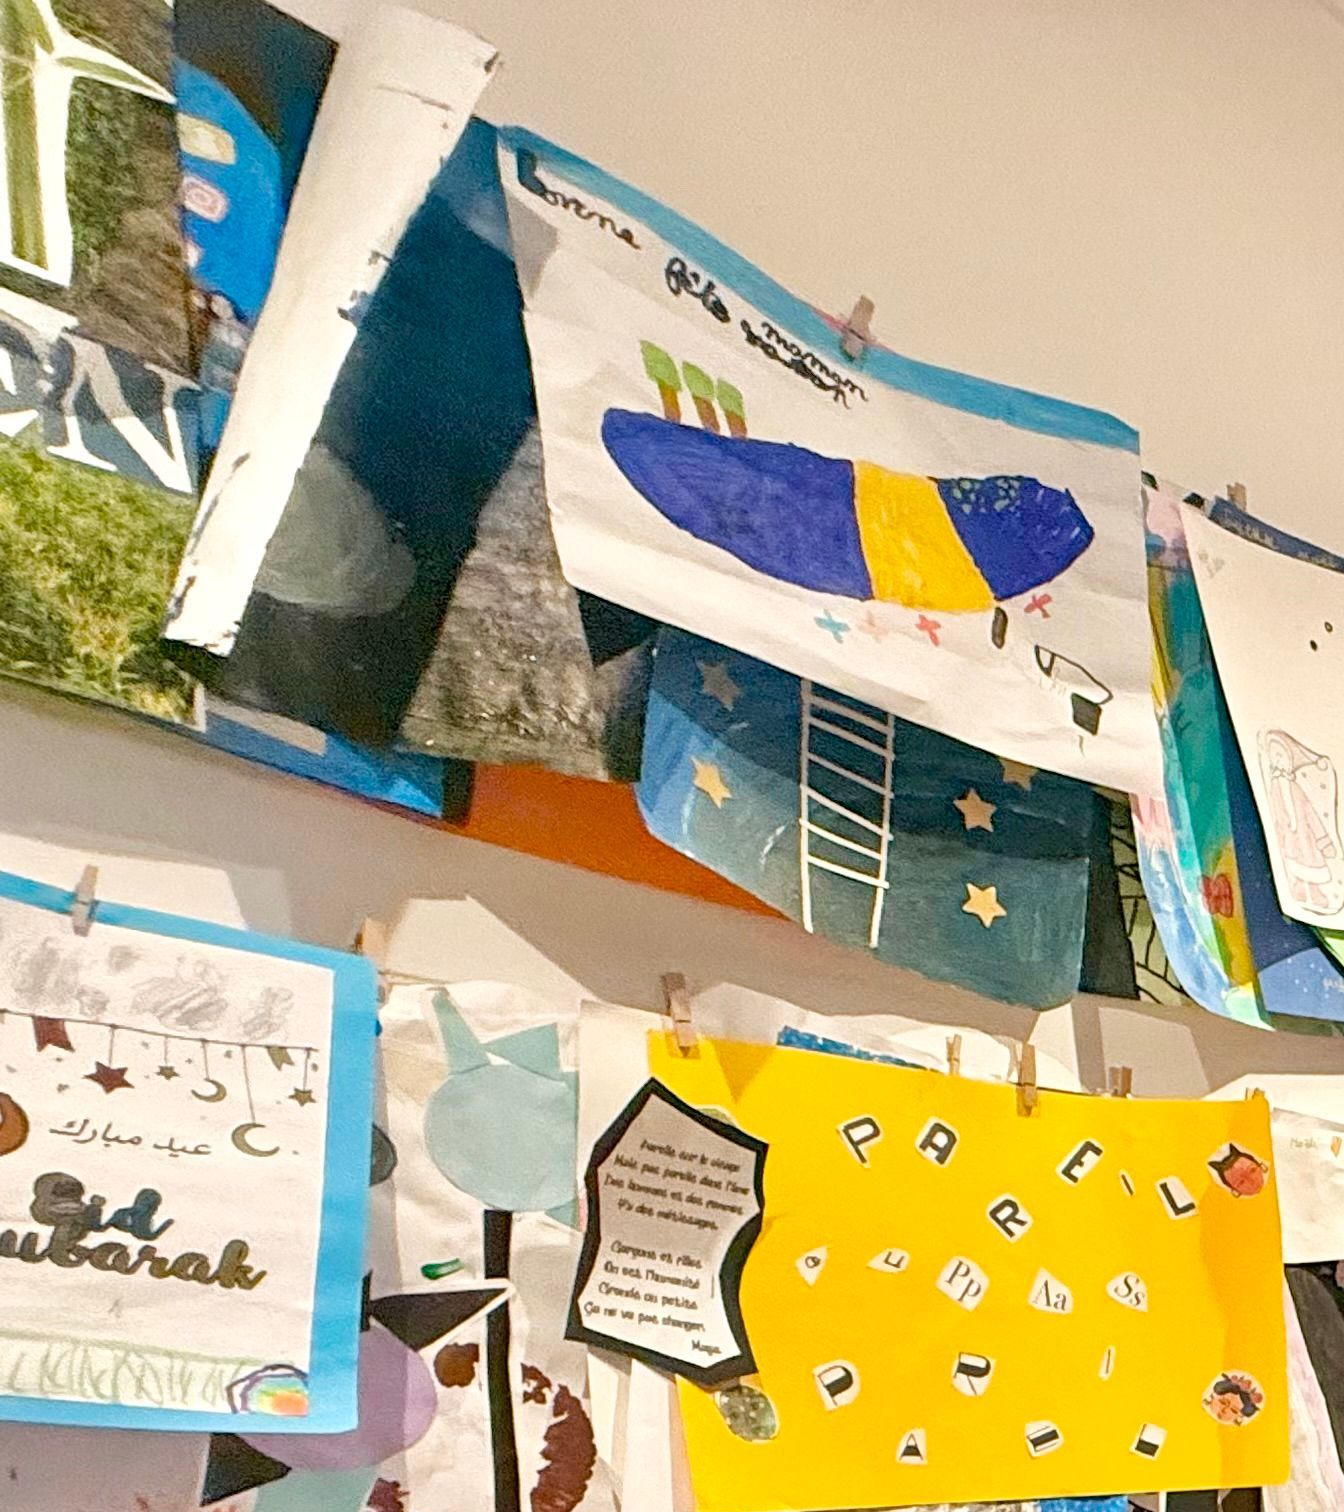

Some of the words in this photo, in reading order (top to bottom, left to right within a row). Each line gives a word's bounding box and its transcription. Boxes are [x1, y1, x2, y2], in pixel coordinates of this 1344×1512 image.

[49, 1118, 143, 1148] مبارك
[153, 1138, 212, 1157] عيد
[30, 1172, 174, 1241] Eid
[0, 1229, 268, 1290] ubarak
[659, 1250, 674, 1264] et
[644, 1291, 658, 1304] ou
[583, 1300, 600, 1317] Ça
